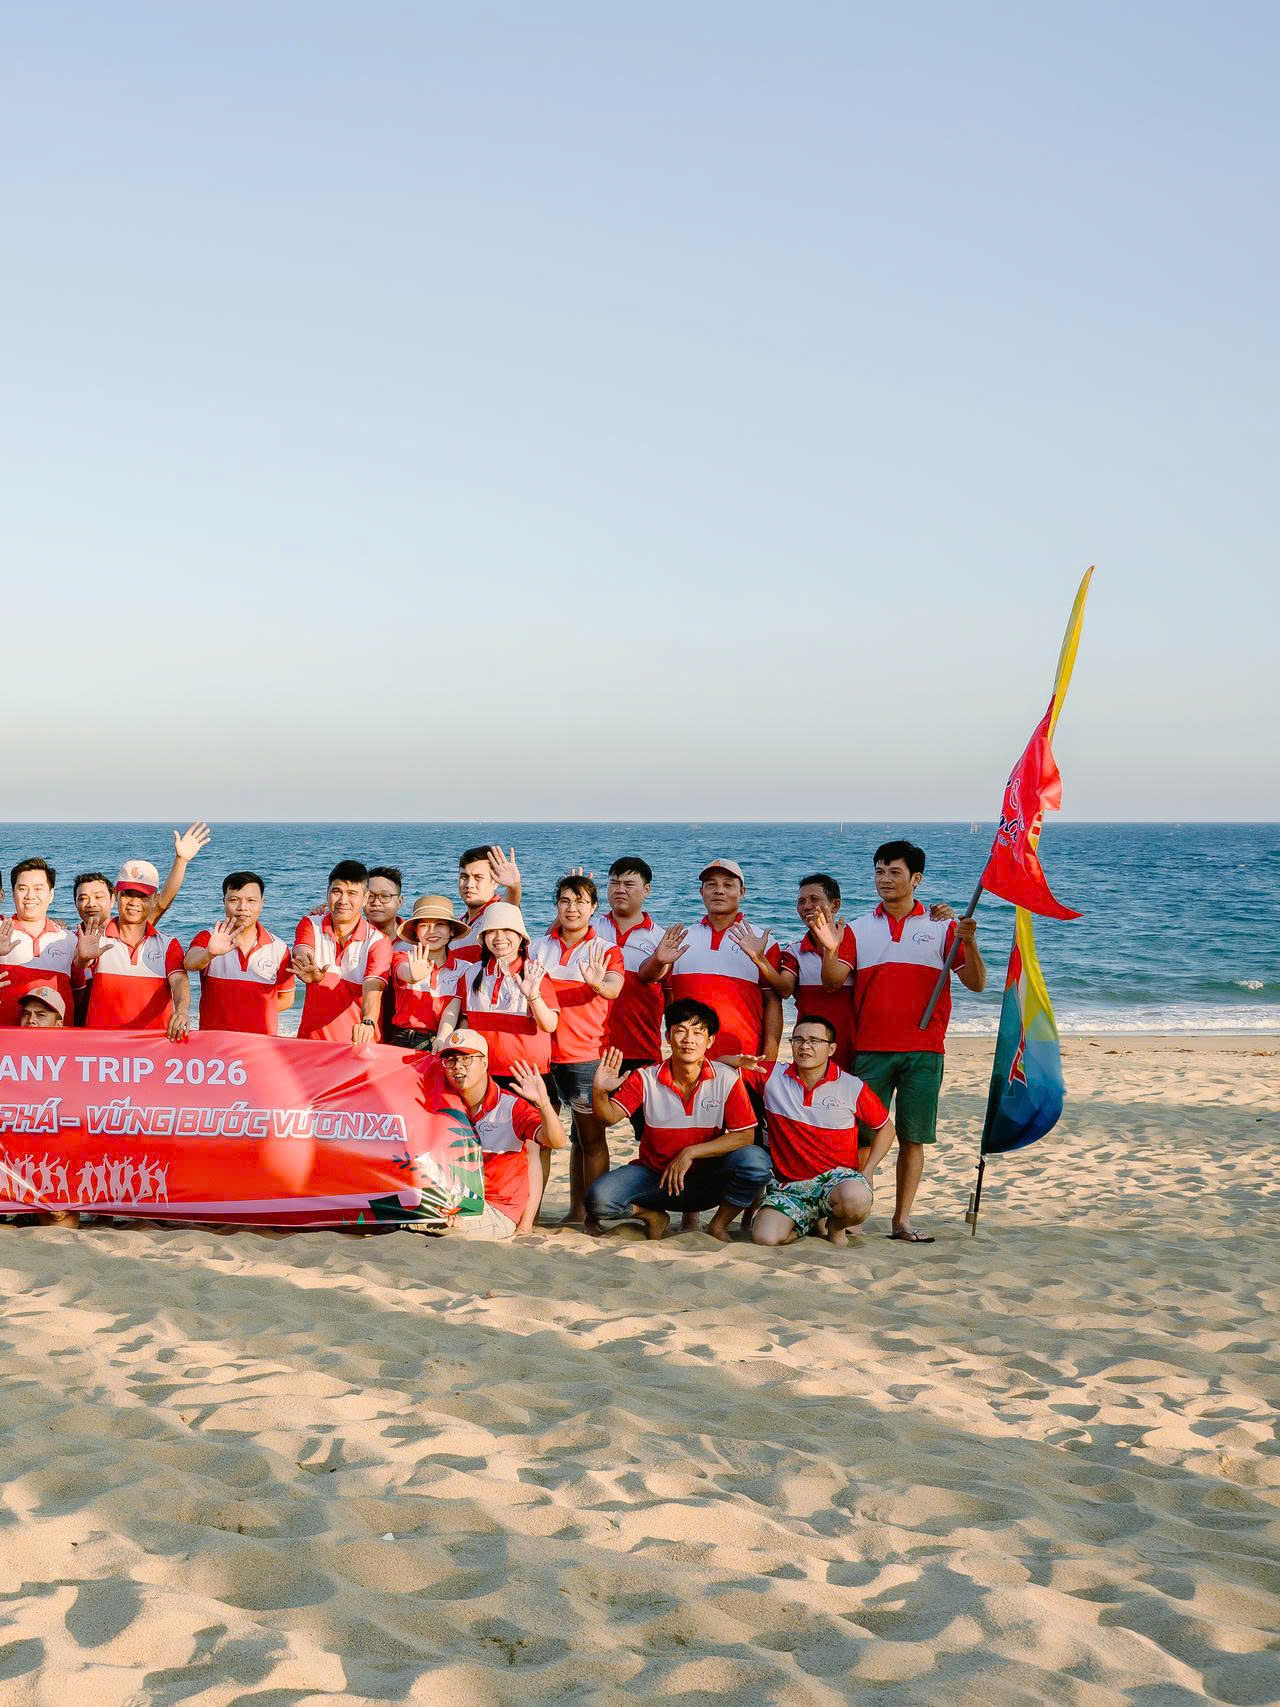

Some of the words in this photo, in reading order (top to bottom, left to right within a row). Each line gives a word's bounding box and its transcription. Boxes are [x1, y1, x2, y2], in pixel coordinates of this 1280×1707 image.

[75, 1056, 155, 1083] TRIP
[165, 1058, 248, 1085] 2026
[86, 1096, 177, 1135] VỮNG
[175, 1101, 272, 1137] BƯỚC
[272, 1108, 368, 1140] VƯƠN
[366, 1112, 409, 1142] XA
